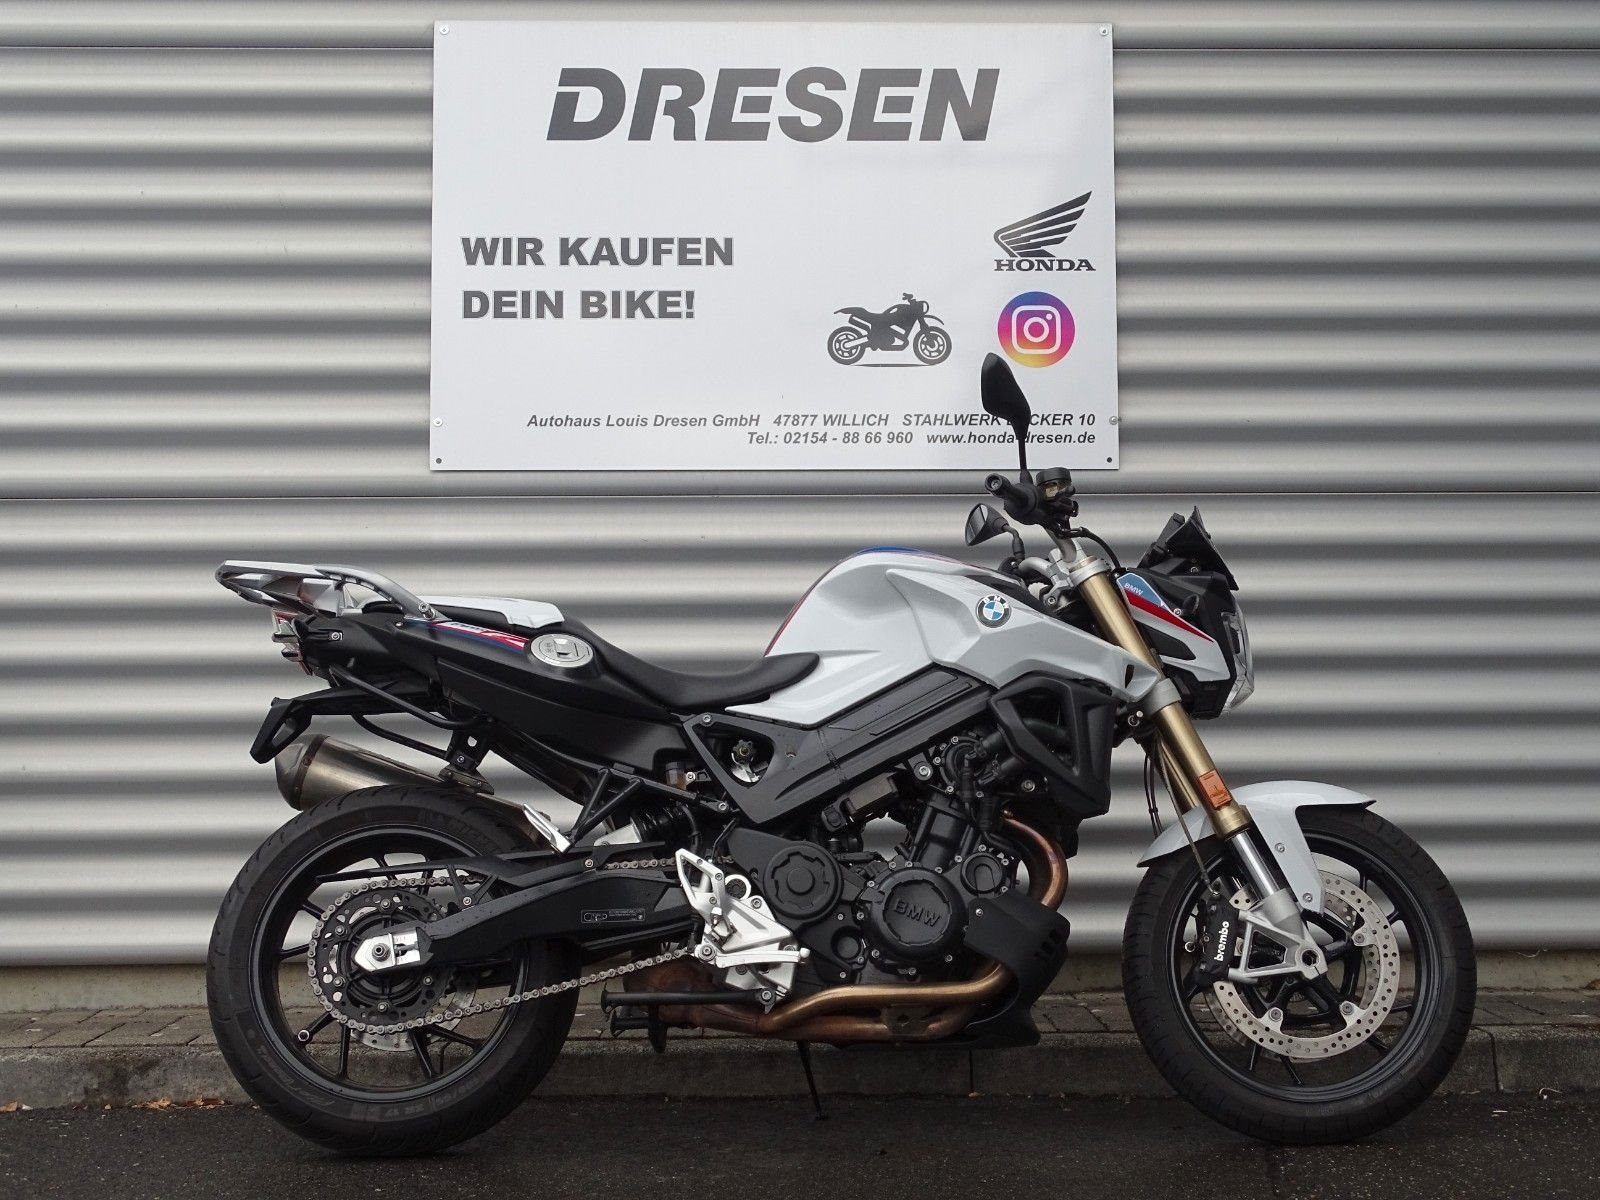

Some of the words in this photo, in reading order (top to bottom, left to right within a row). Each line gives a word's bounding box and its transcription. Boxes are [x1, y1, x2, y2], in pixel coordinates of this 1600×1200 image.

[547, 67, 1000, 143] DRESEN
[461, 236, 545, 267] WIR
[559, 236, 734, 267] KAUFEN
[994, 258, 1097, 272] HONDA
[463, 289, 564, 319] DEIN
[580, 289, 695, 319] BIKE!
[526, 414, 602, 428] Autohaus
[605, 414, 649, 428] Louis
[652, 414, 708, 428] Dresen
[712, 413, 761, 428] GmbH
[772, 413, 819, 427] 47877
[823, 413, 890, 427] WILLICH
[902, 413, 1002, 427] STAHLWERK
[1006, 413, 1074, 426] CKER
[1078, 413, 1096, 426] 10
[747, 431, 779, 445] Tel.:
[783, 431, 828, 444] 02154
[842, 431, 860, 444] 88
[864, 431, 882, 444] 66
[886, 431, 914, 444] 960
[1124, 582, 1144, 596] BMW
[894, 899, 941, 927] BMW
[1213, 920, 1230, 962] brembo
